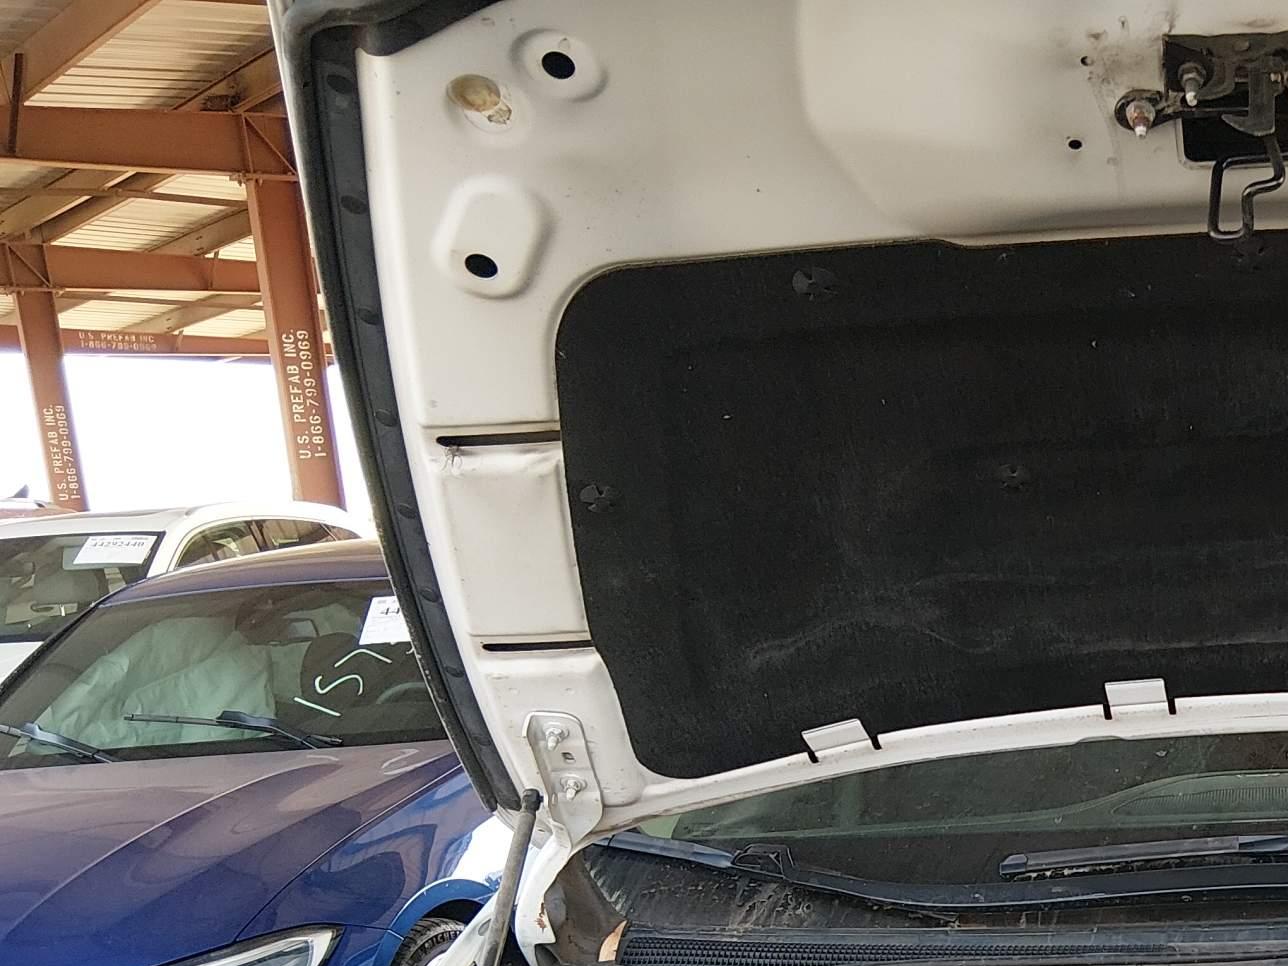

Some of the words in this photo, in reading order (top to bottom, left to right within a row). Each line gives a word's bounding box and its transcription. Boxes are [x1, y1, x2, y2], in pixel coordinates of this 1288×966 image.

[281, 329, 297, 357] INC.
[286, 365, 307, 423] PREFAB
[296, 330, 327, 457] 1-866-799-0969
[43, 404, 56, 426] INC.
[47, 431, 65, 474] PREFAB
[55, 405, 81, 499] 1-866-799-0969
[297, 430, 312, 459] U.S.
[57, 479, 69, 501] U.S.
